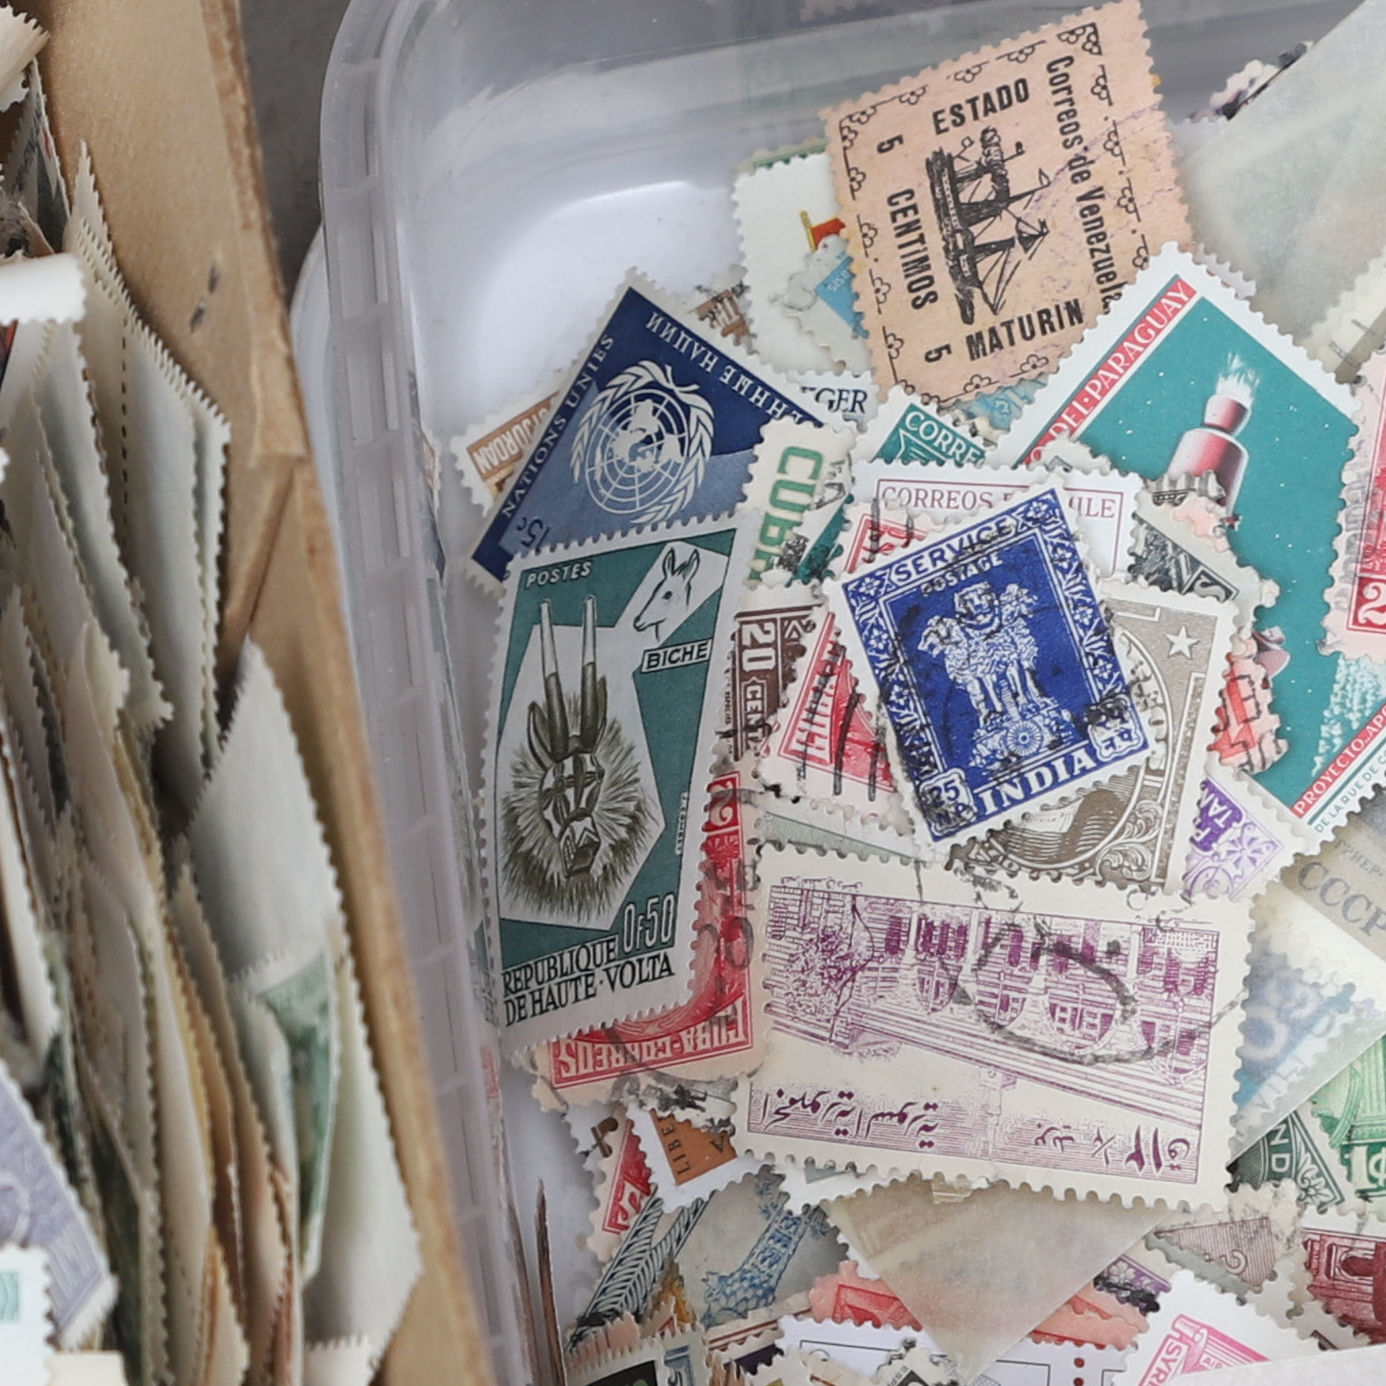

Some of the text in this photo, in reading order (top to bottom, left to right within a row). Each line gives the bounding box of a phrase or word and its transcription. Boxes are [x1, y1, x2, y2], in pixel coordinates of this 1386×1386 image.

[932, 76, 1032, 136] ESTADO
[1045, 54, 1084, 151] Correos
[1066, 151, 1092, 185] de
[875, 133, 940, 312] 5 CENTIMOS
[923, 342, 954, 364] 5
[964, 297, 1086, 363] MATURIN
[1088, 278, 1196, 402] PARAGUAY
[502, 334, 615, 520] NATIONS UNIES
[881, 485, 994, 512] CORREOS
[524, 558, 593, 589] POSTES
[644, 641, 711, 670] BICHE
[976, 751, 1097, 818] INDIA
[1295, 737, 1366, 819] PROYECTO
[502, 935, 619, 1001] REPUBLIQUE
